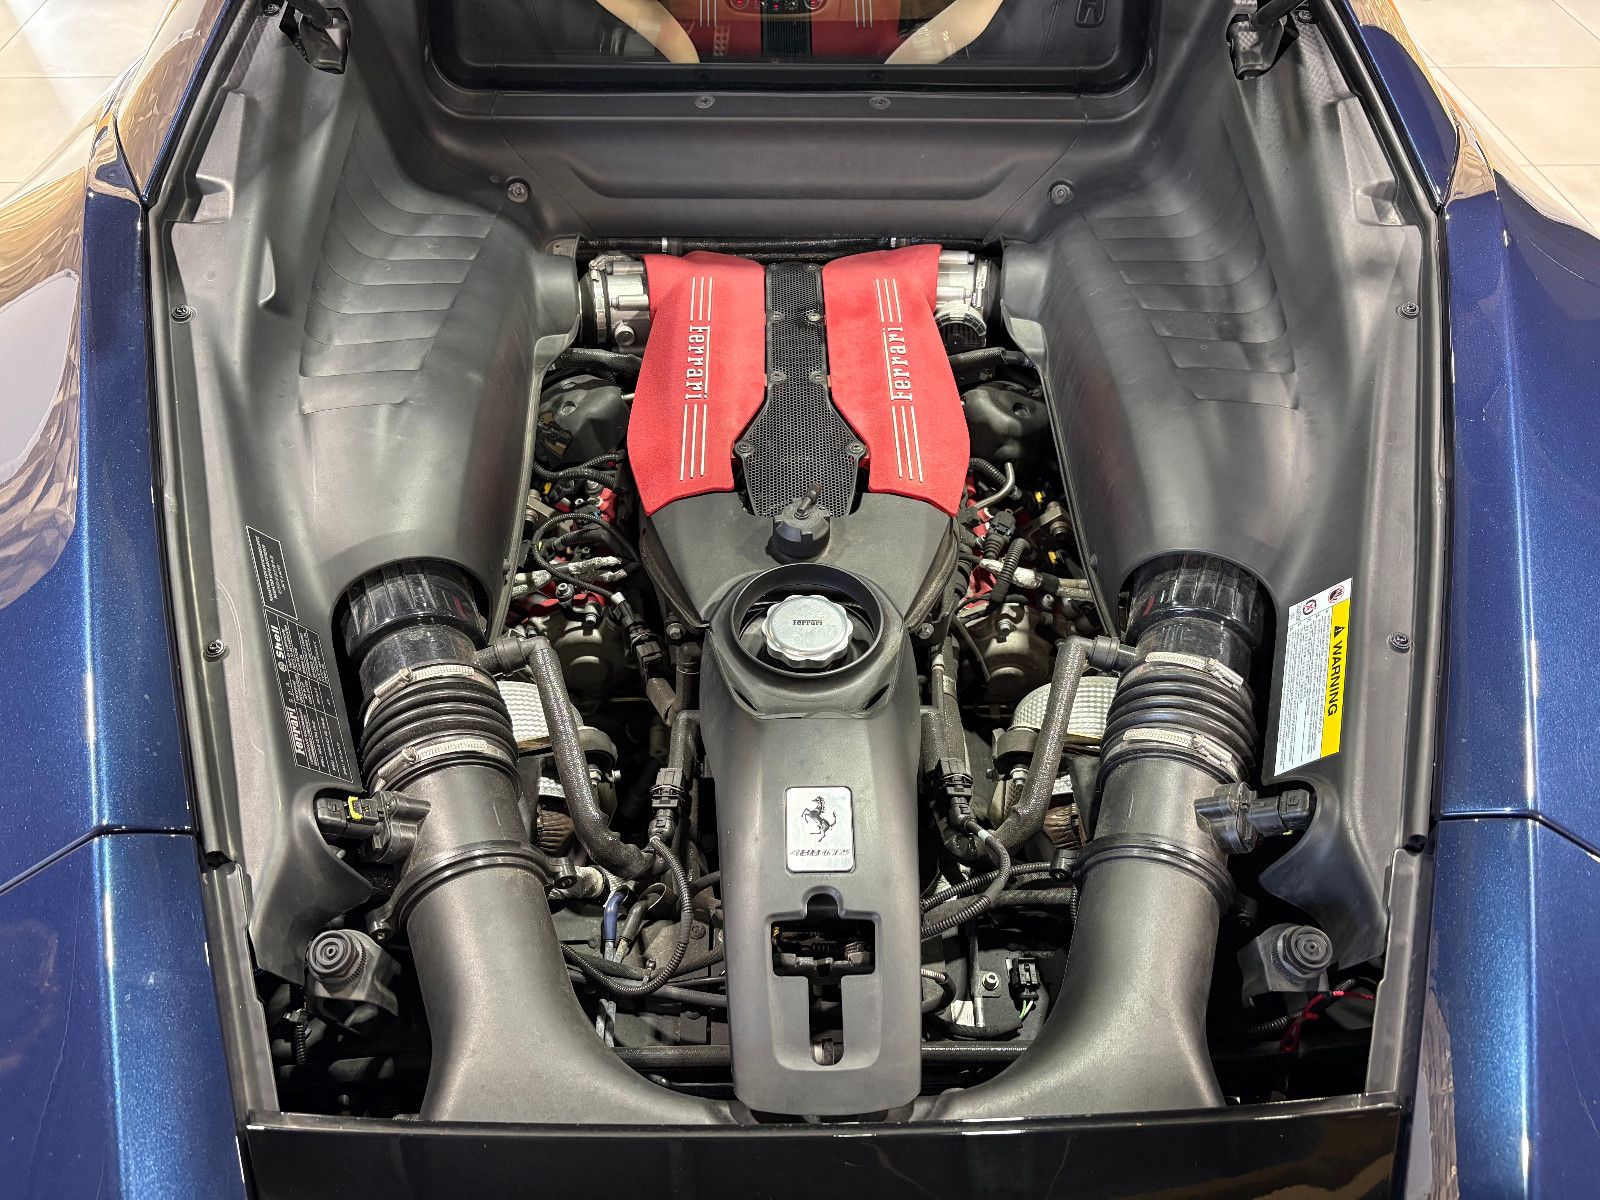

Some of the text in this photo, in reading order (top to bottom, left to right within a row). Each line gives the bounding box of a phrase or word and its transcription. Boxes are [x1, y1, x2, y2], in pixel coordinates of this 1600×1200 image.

[685, 325, 711, 399] Ferrari
[882, 327, 912, 402] Ferrari
[270, 624, 284, 660] Shell
[1327, 640, 1342, 717] WARNING
[284, 705, 306, 757] Ferrari
